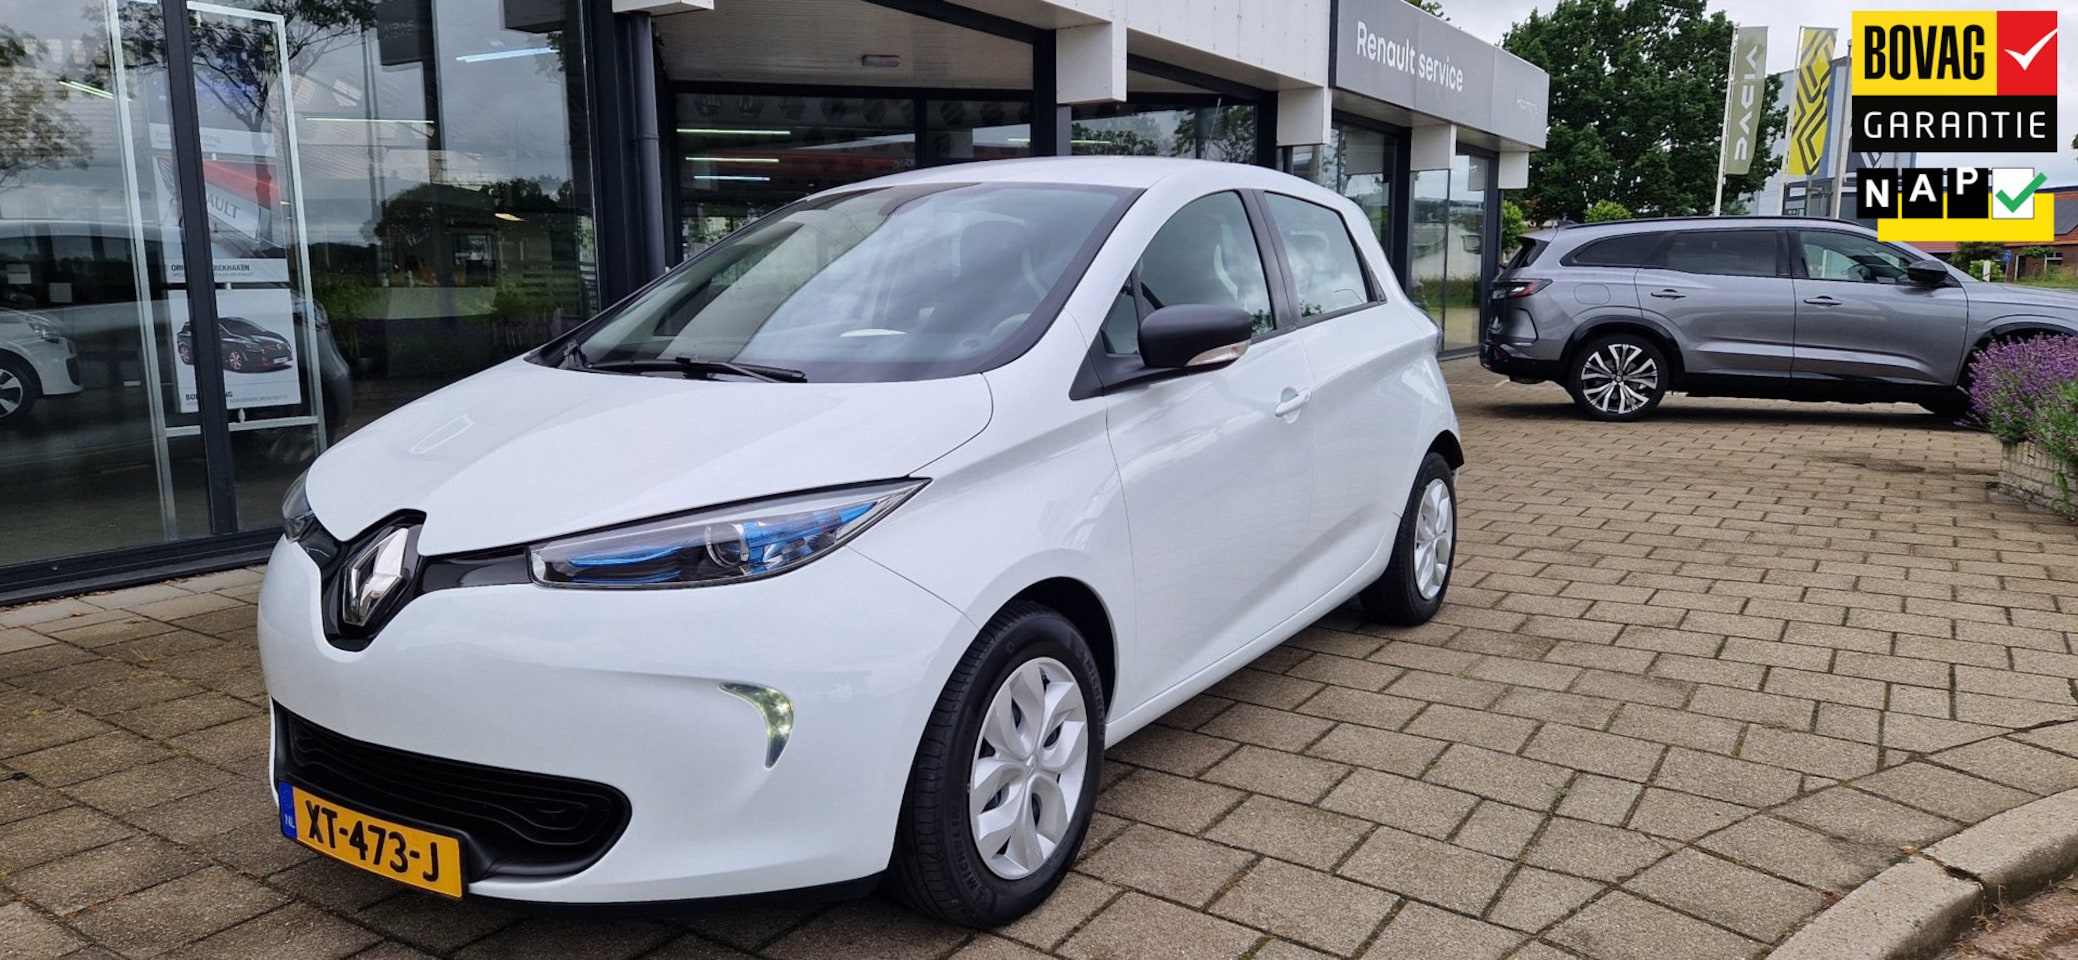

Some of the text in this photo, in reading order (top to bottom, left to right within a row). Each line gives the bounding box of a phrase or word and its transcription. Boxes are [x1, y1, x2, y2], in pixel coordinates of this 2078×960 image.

[1357, 21, 1463, 92] Renault service
[1734, 45, 1758, 160] DACIA
[207, 193, 241, 219] AULT
[284, 813, 296, 829] NL
[305, 800, 439, 882] XT-473-J
